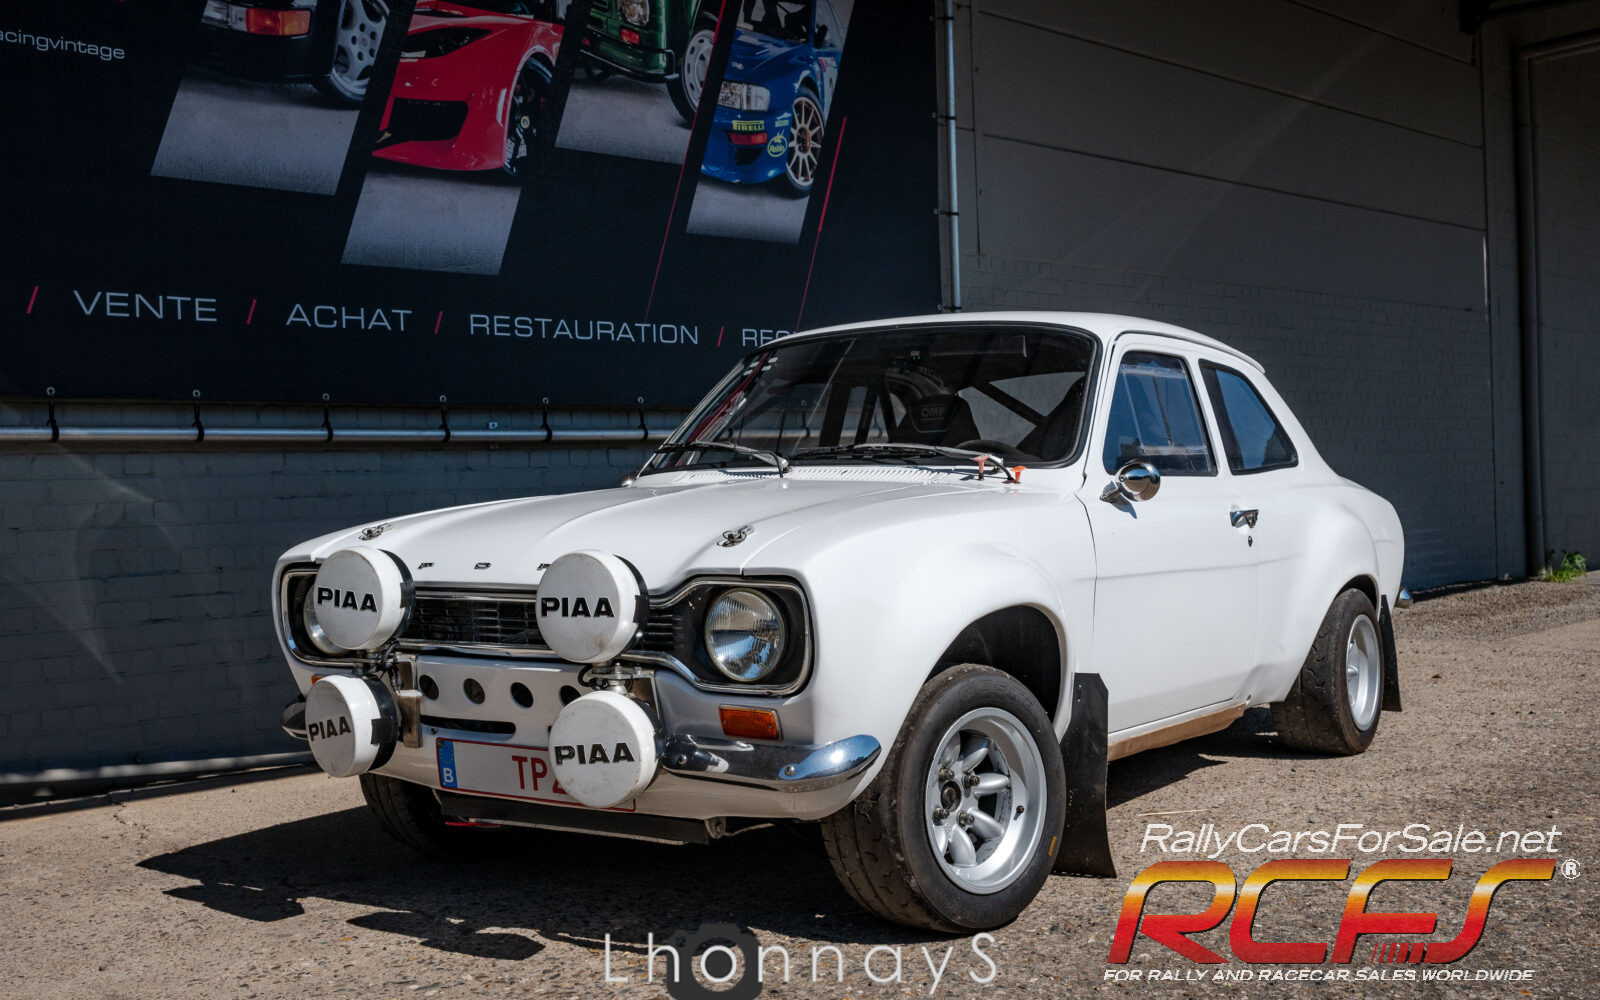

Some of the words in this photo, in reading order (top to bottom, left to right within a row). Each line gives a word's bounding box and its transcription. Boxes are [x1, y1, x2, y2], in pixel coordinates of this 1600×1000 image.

[73, 290, 217, 322] VENTE
[286, 303, 412, 331] ACHAT
[469, 314, 698, 345] RESTAURATION
[742, 328, 797, 348] RE
[921, 407, 944, 417] OMP
[317, 587, 378, 613] PIAA
[541, 597, 615, 618] PIAA
[308, 716, 352, 742] PIAA
[554, 742, 635, 765] PIAA
[443, 767, 454, 783] B
